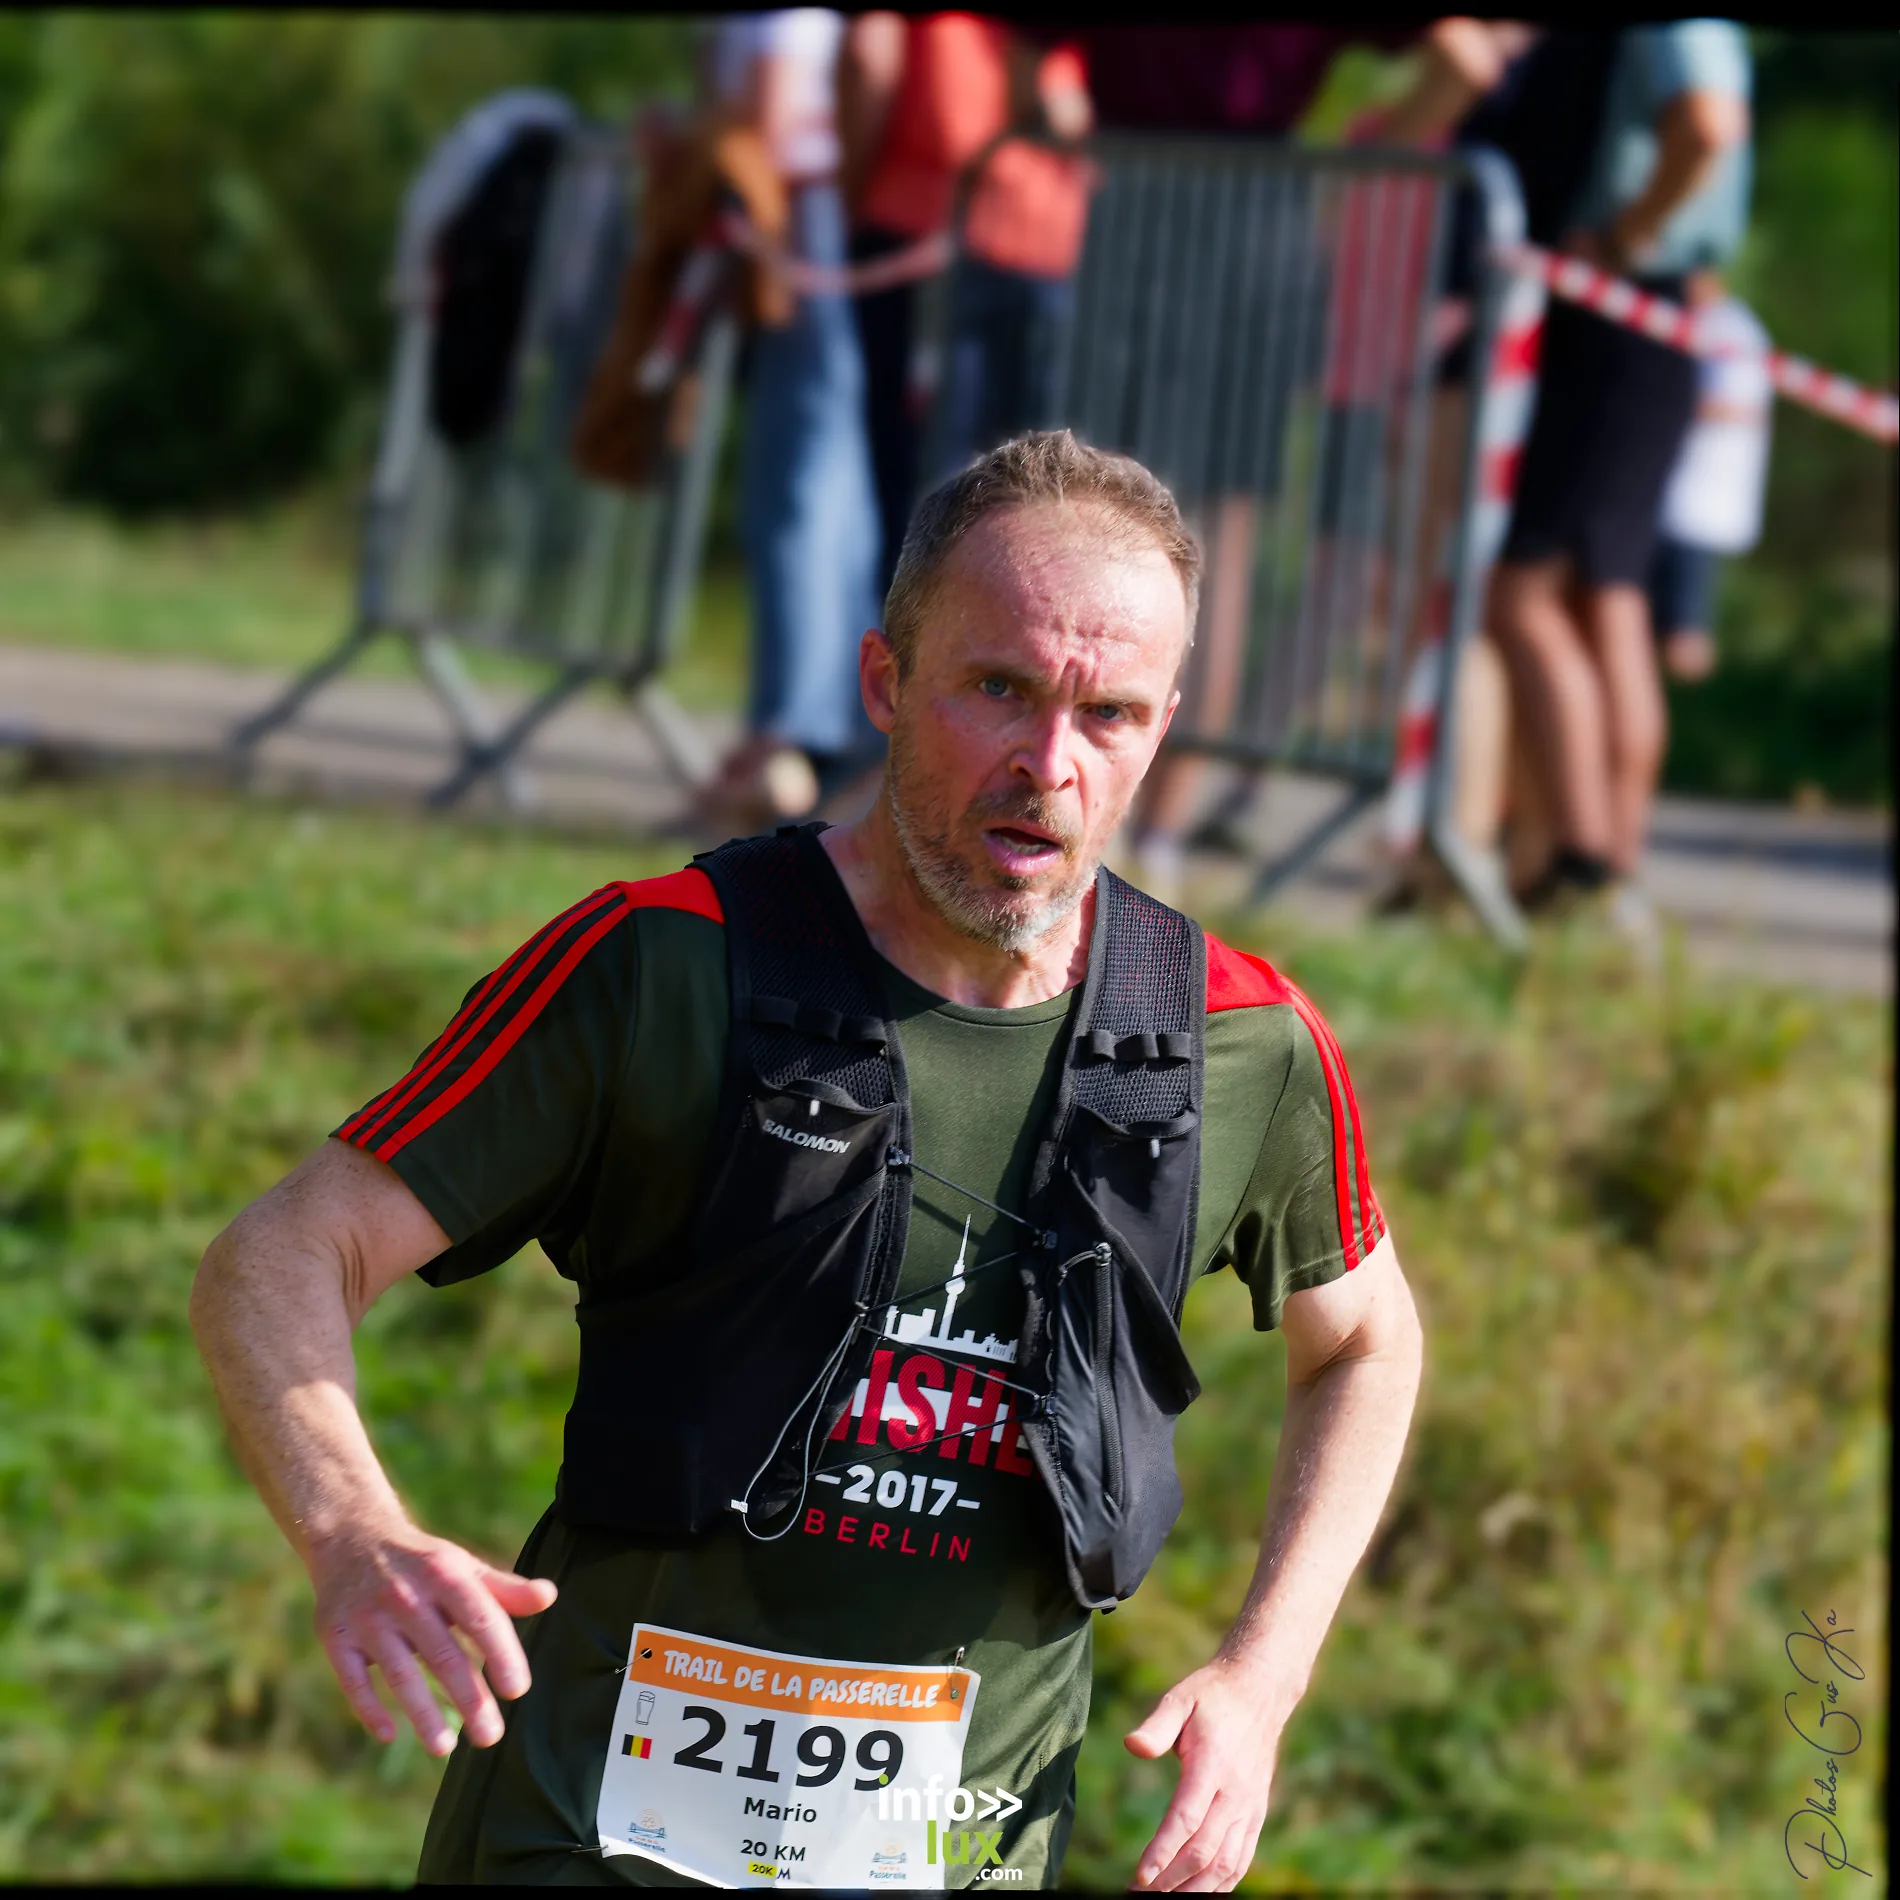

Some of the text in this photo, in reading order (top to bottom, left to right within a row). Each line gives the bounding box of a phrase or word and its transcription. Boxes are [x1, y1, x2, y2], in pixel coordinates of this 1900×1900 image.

[761, 1118, 851, 1154] SALOMON
[804, 1507, 971, 1562] BERLIN
[663, 1649, 940, 1709] TRAIL DE LA PASSERELLE
[673, 1705, 904, 1792] 2199
[743, 1796, 818, 1824] Mario
[740, 1839, 806, 1862] 20 KM
